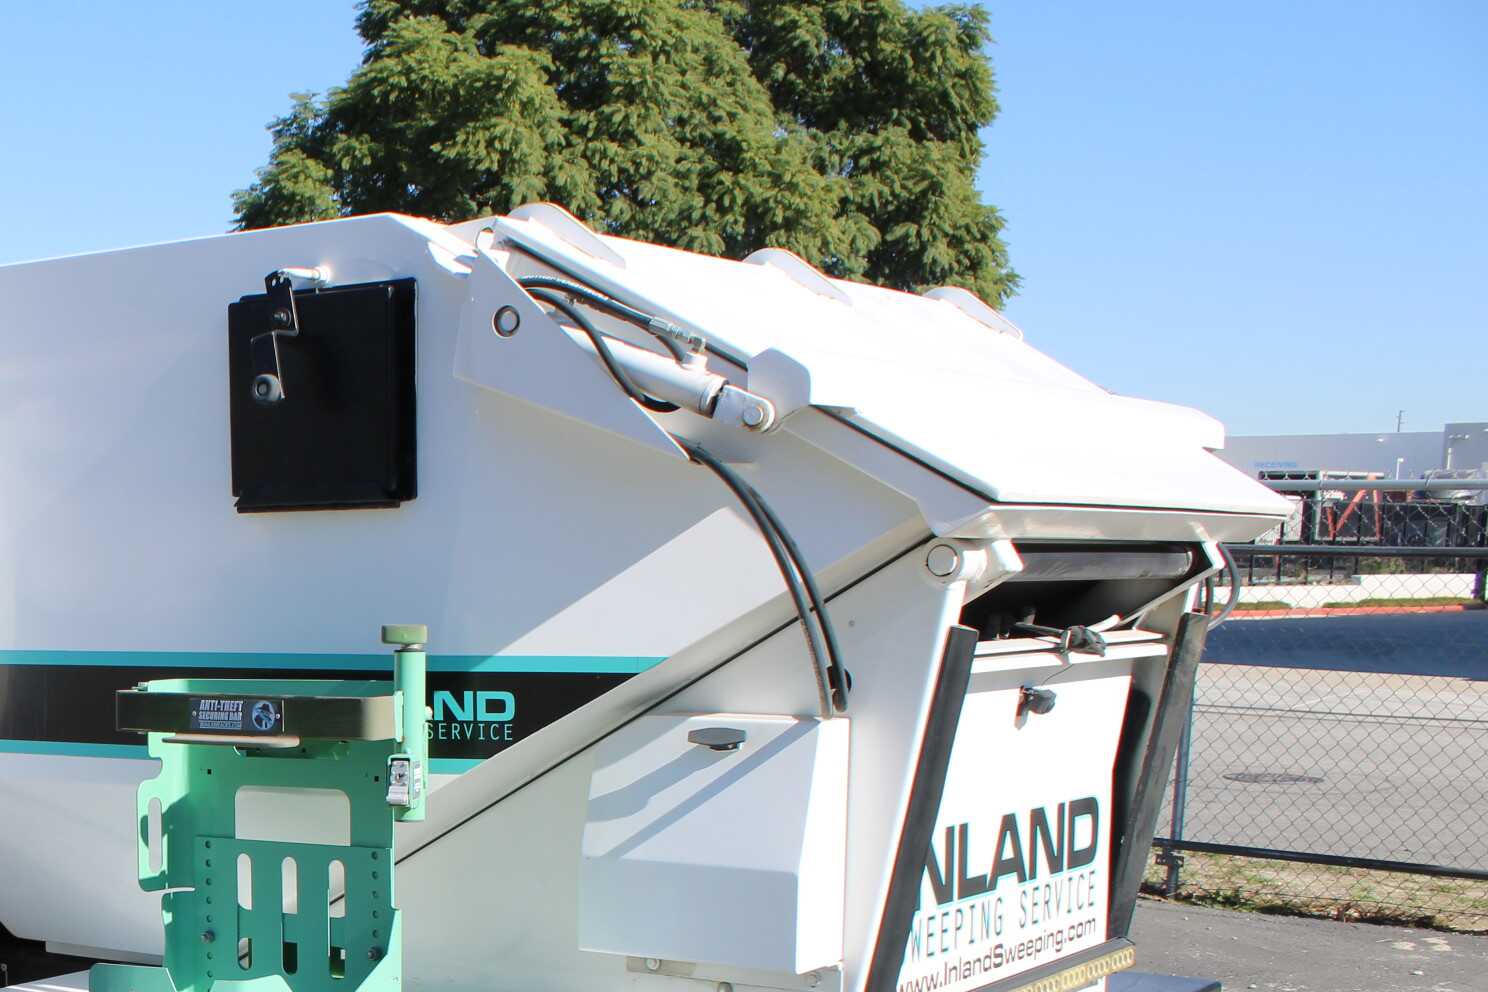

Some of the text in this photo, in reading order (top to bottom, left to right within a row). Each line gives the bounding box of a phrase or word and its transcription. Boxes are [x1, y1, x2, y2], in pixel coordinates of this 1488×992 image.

[199, 700, 244, 712] ANTI-THEFT
[426, 723, 513, 741] SERVICE
[914, 796, 1100, 911] NLAND
[911, 869, 1096, 964] WEEPING SERVICE
